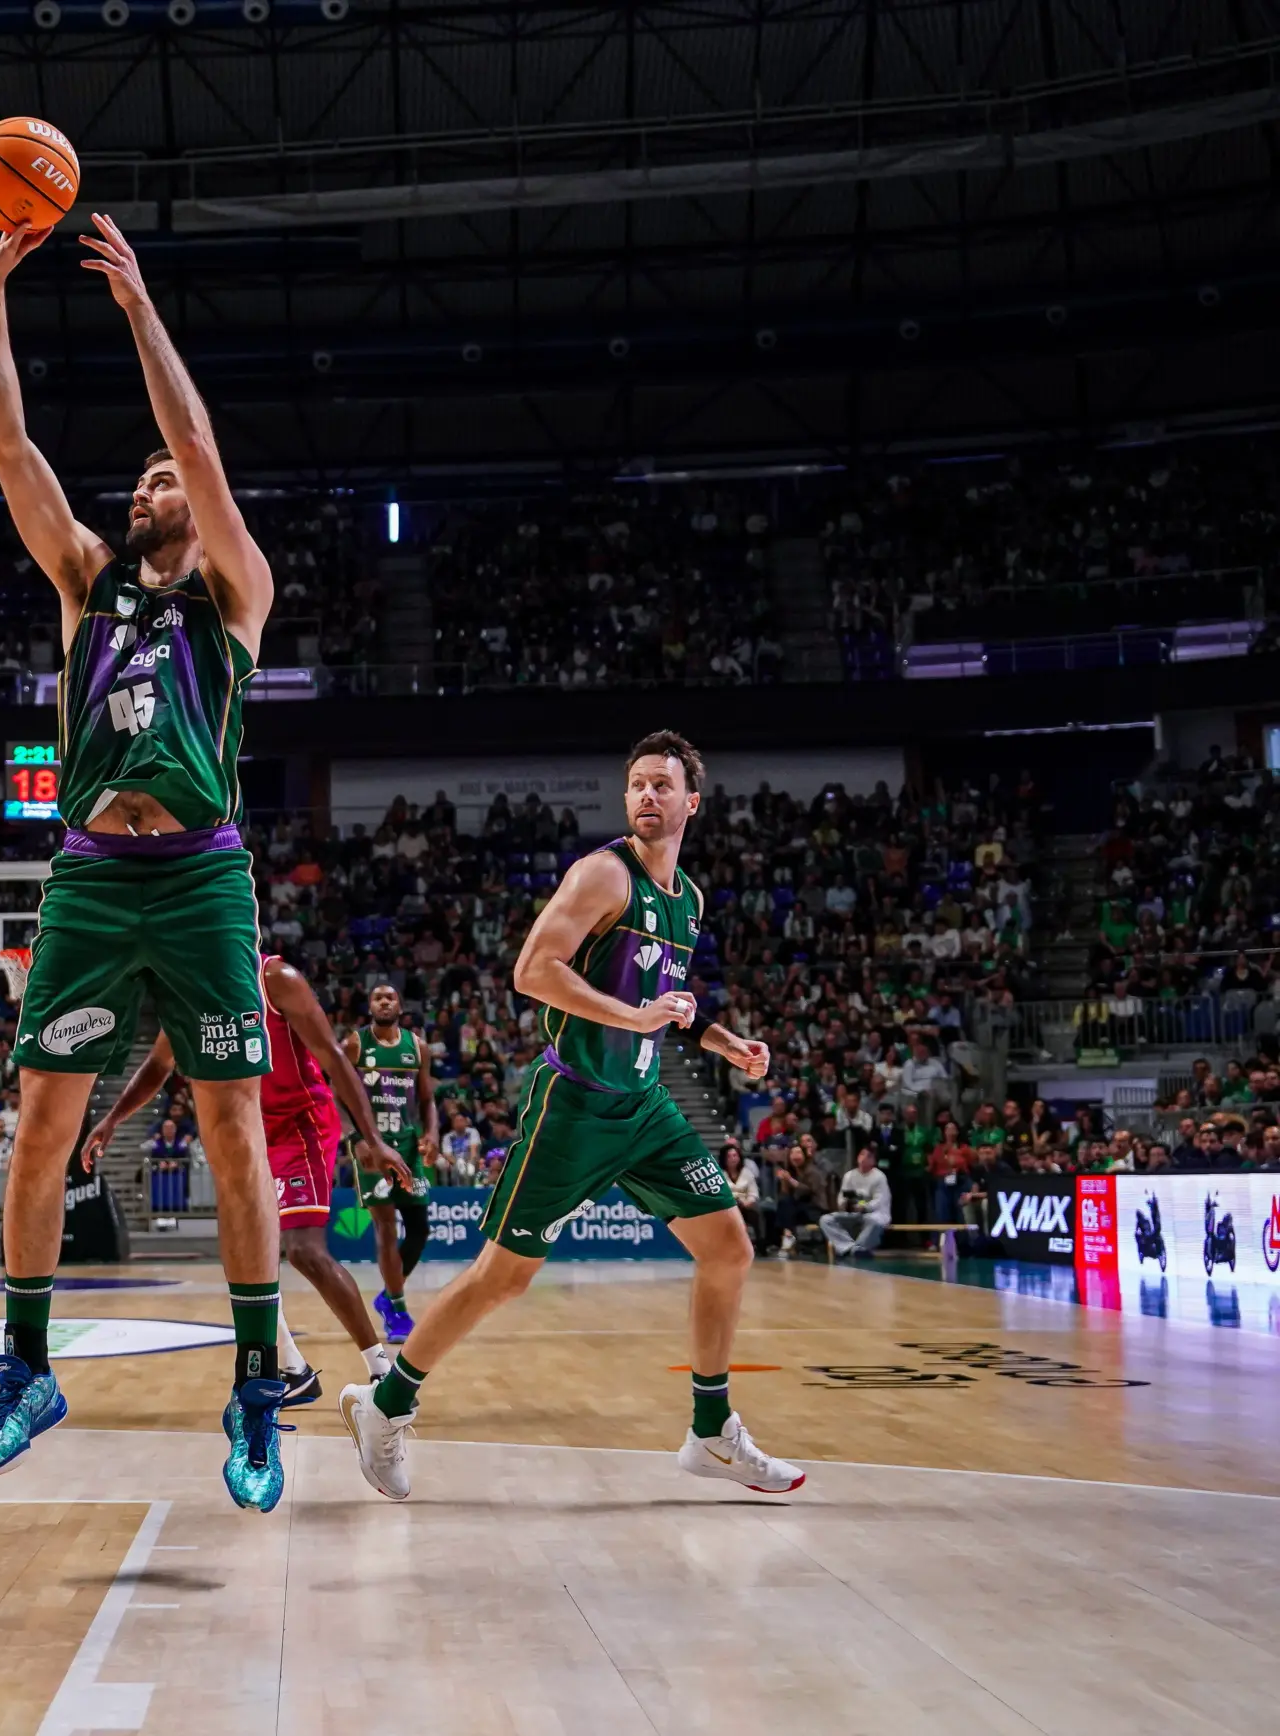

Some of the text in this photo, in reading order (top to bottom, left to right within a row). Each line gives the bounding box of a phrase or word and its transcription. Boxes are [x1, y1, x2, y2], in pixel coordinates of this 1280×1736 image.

[107, 681, 155, 736] 45
[14, 746, 55, 764] 2:21
[12, 769, 57, 802] 18
[46, 1011, 113, 1047] famadesa
[201, 1036, 240, 1061] laga
[634, 1038, 654, 1078] 4
[381, 1075, 414, 1088] Unicaja
[372, 1093, 407, 1105] málaga
[376, 1111, 401, 1132] 55
[680, 1158, 704, 1173] sabor
[65, 1176, 101, 1210] guel
[689, 1174, 725, 1195] laga
[990, 1191, 1072, 1239] XMAX
[571, 1220, 654, 1245] Unicaja
[1048, 1237, 1073, 1253] 125
